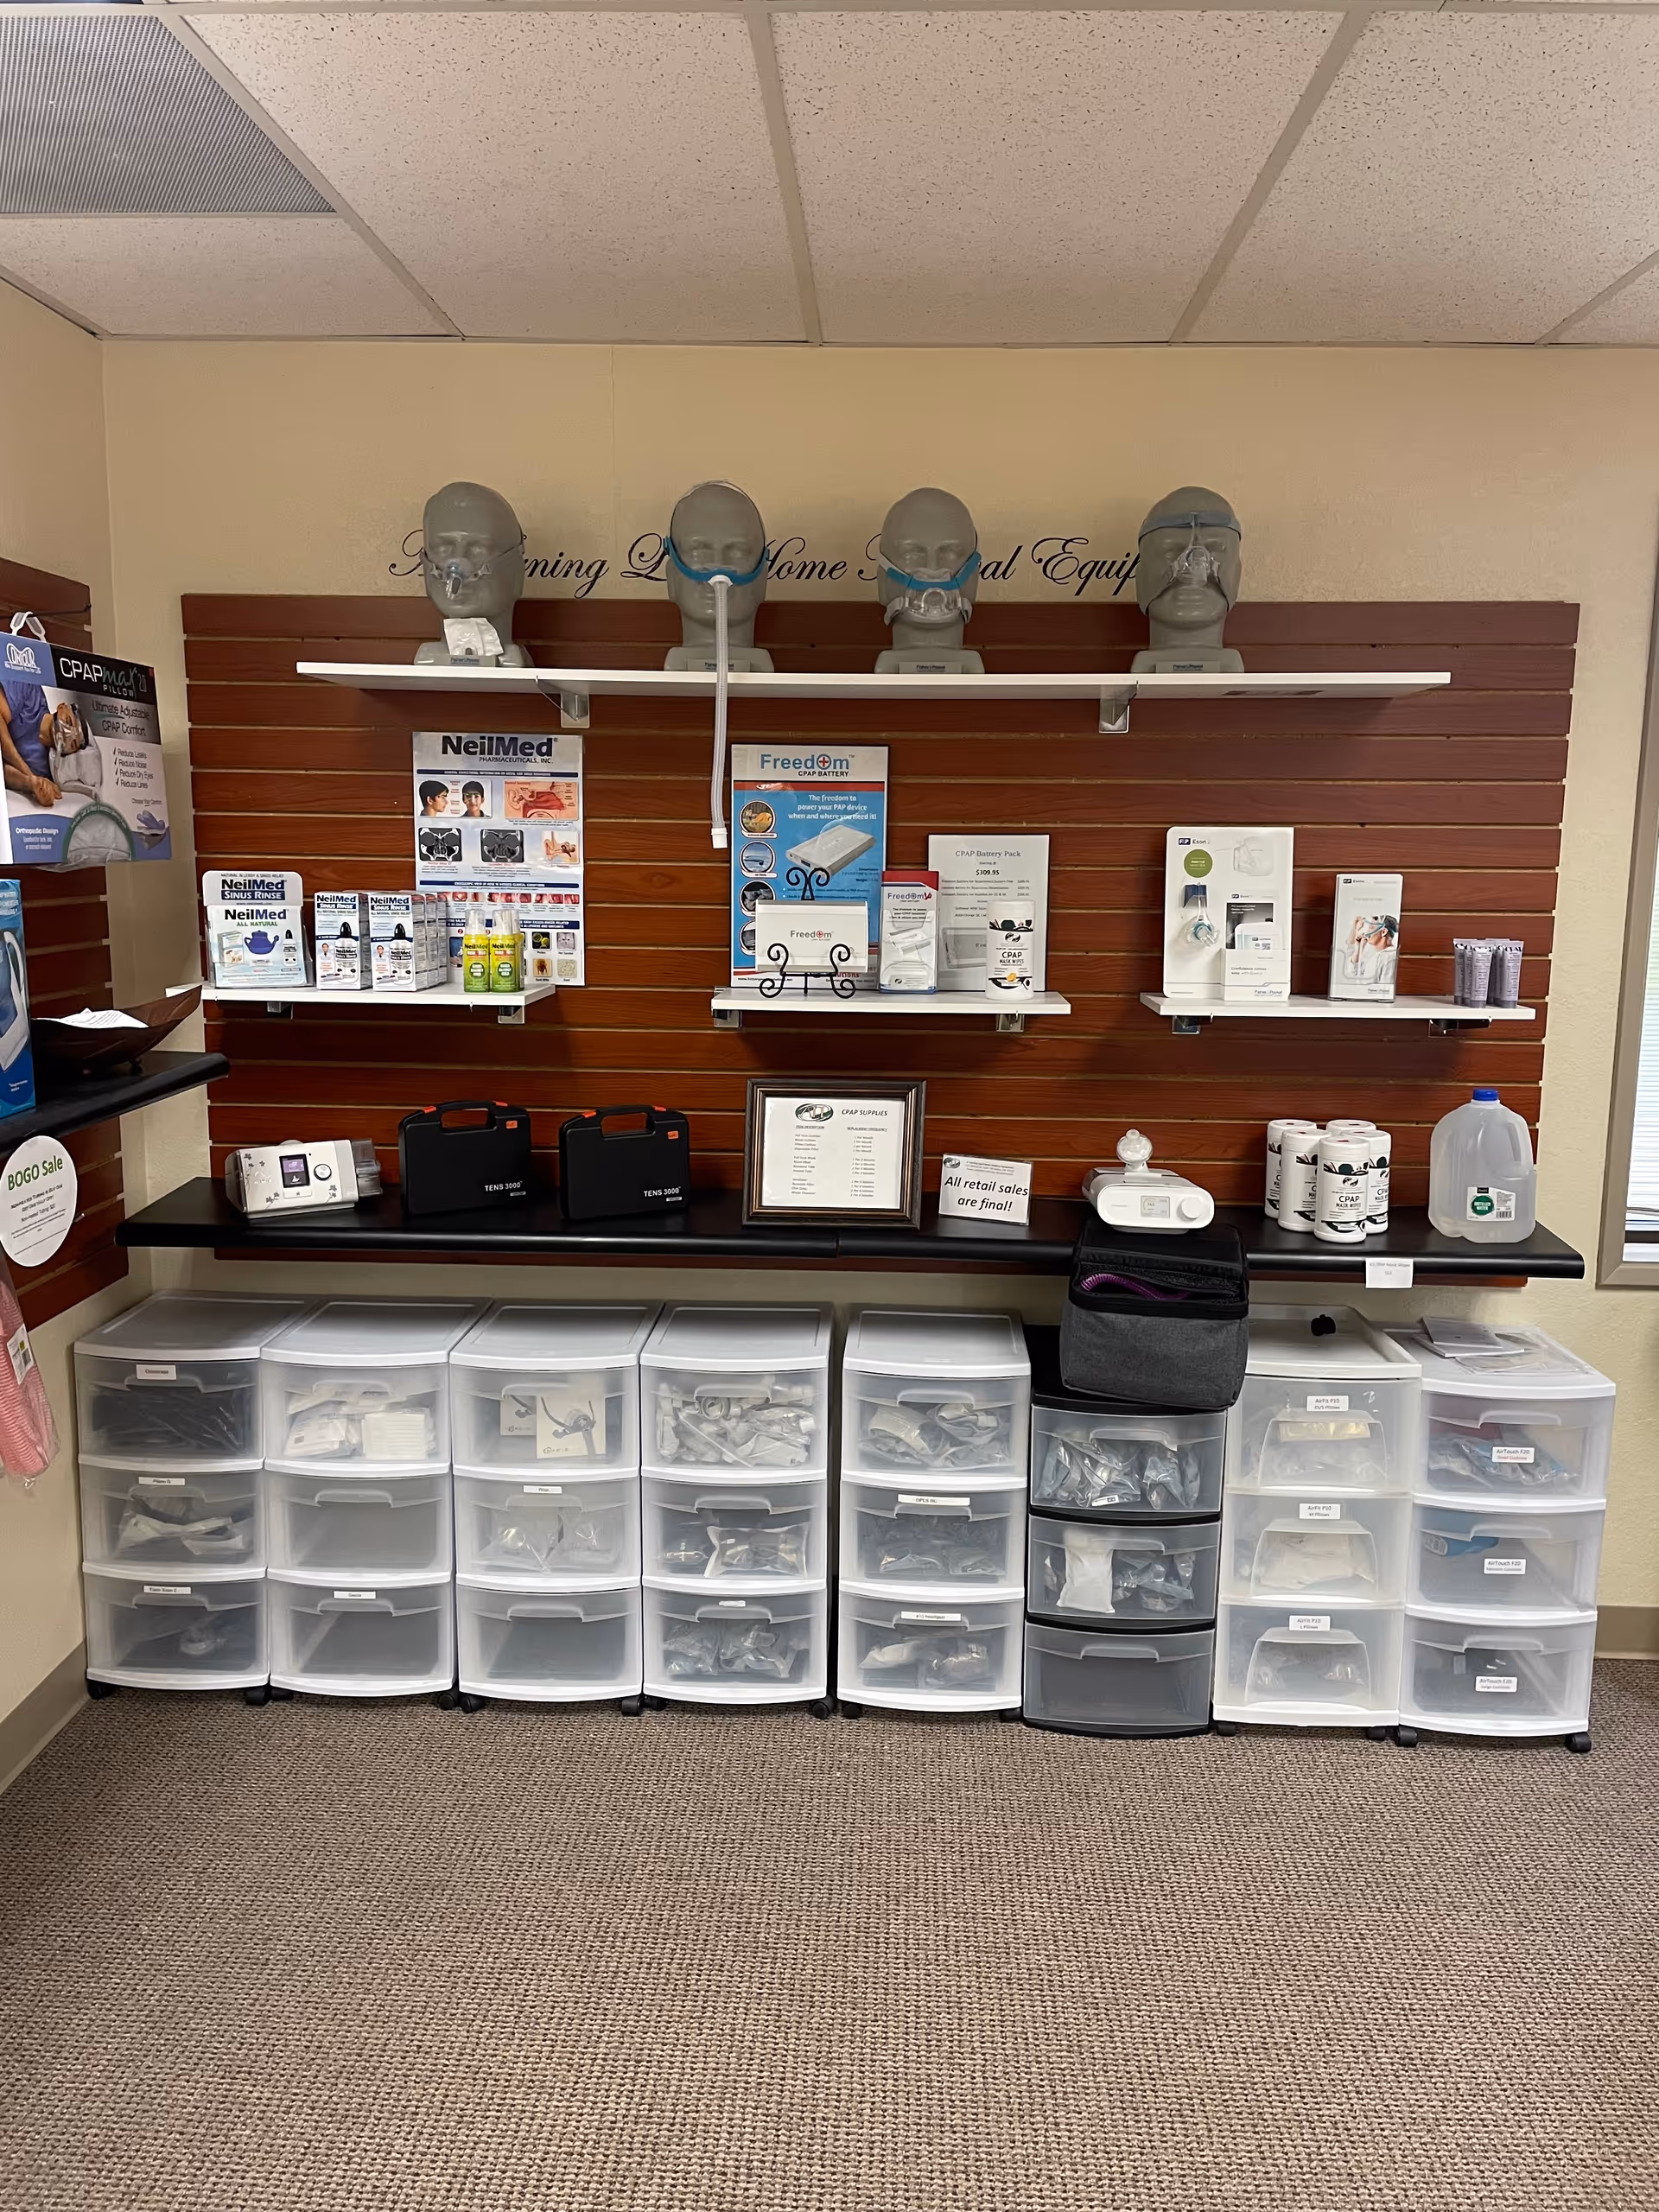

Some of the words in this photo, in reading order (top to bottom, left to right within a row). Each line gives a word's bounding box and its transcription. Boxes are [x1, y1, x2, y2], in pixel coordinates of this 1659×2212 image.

[103, 685, 135, 696] PILLOW
[92, 699, 118, 714] Ultimate
[119, 705, 150, 720] Adjustable
[102, 720, 120, 733] CPAP
[122, 722, 146, 736] Comfort
[442, 734, 553, 757] NeilMed
[118, 748, 134, 757] Reduce
[118, 758, 135, 767] Reduce
[119, 768, 136, 778] Reduce
[144, 772, 154, 780] Eyes
[120, 779, 137, 787] Reduce
[221, 879, 284, 889] NeilMed
[225, 909, 287, 919] NeilMed
[8, 1164, 40, 1191] BOGO
[42, 1155, 63, 1177] Sale
[505, 1181, 521, 1190] 3000
[944, 1176, 962, 1187] All
[963, 1180, 996, 1192] retail
[998, 1184, 1028, 1196] sales
[957, 1197, 977, 1207] are
[979, 1198, 1013, 1211] final!
